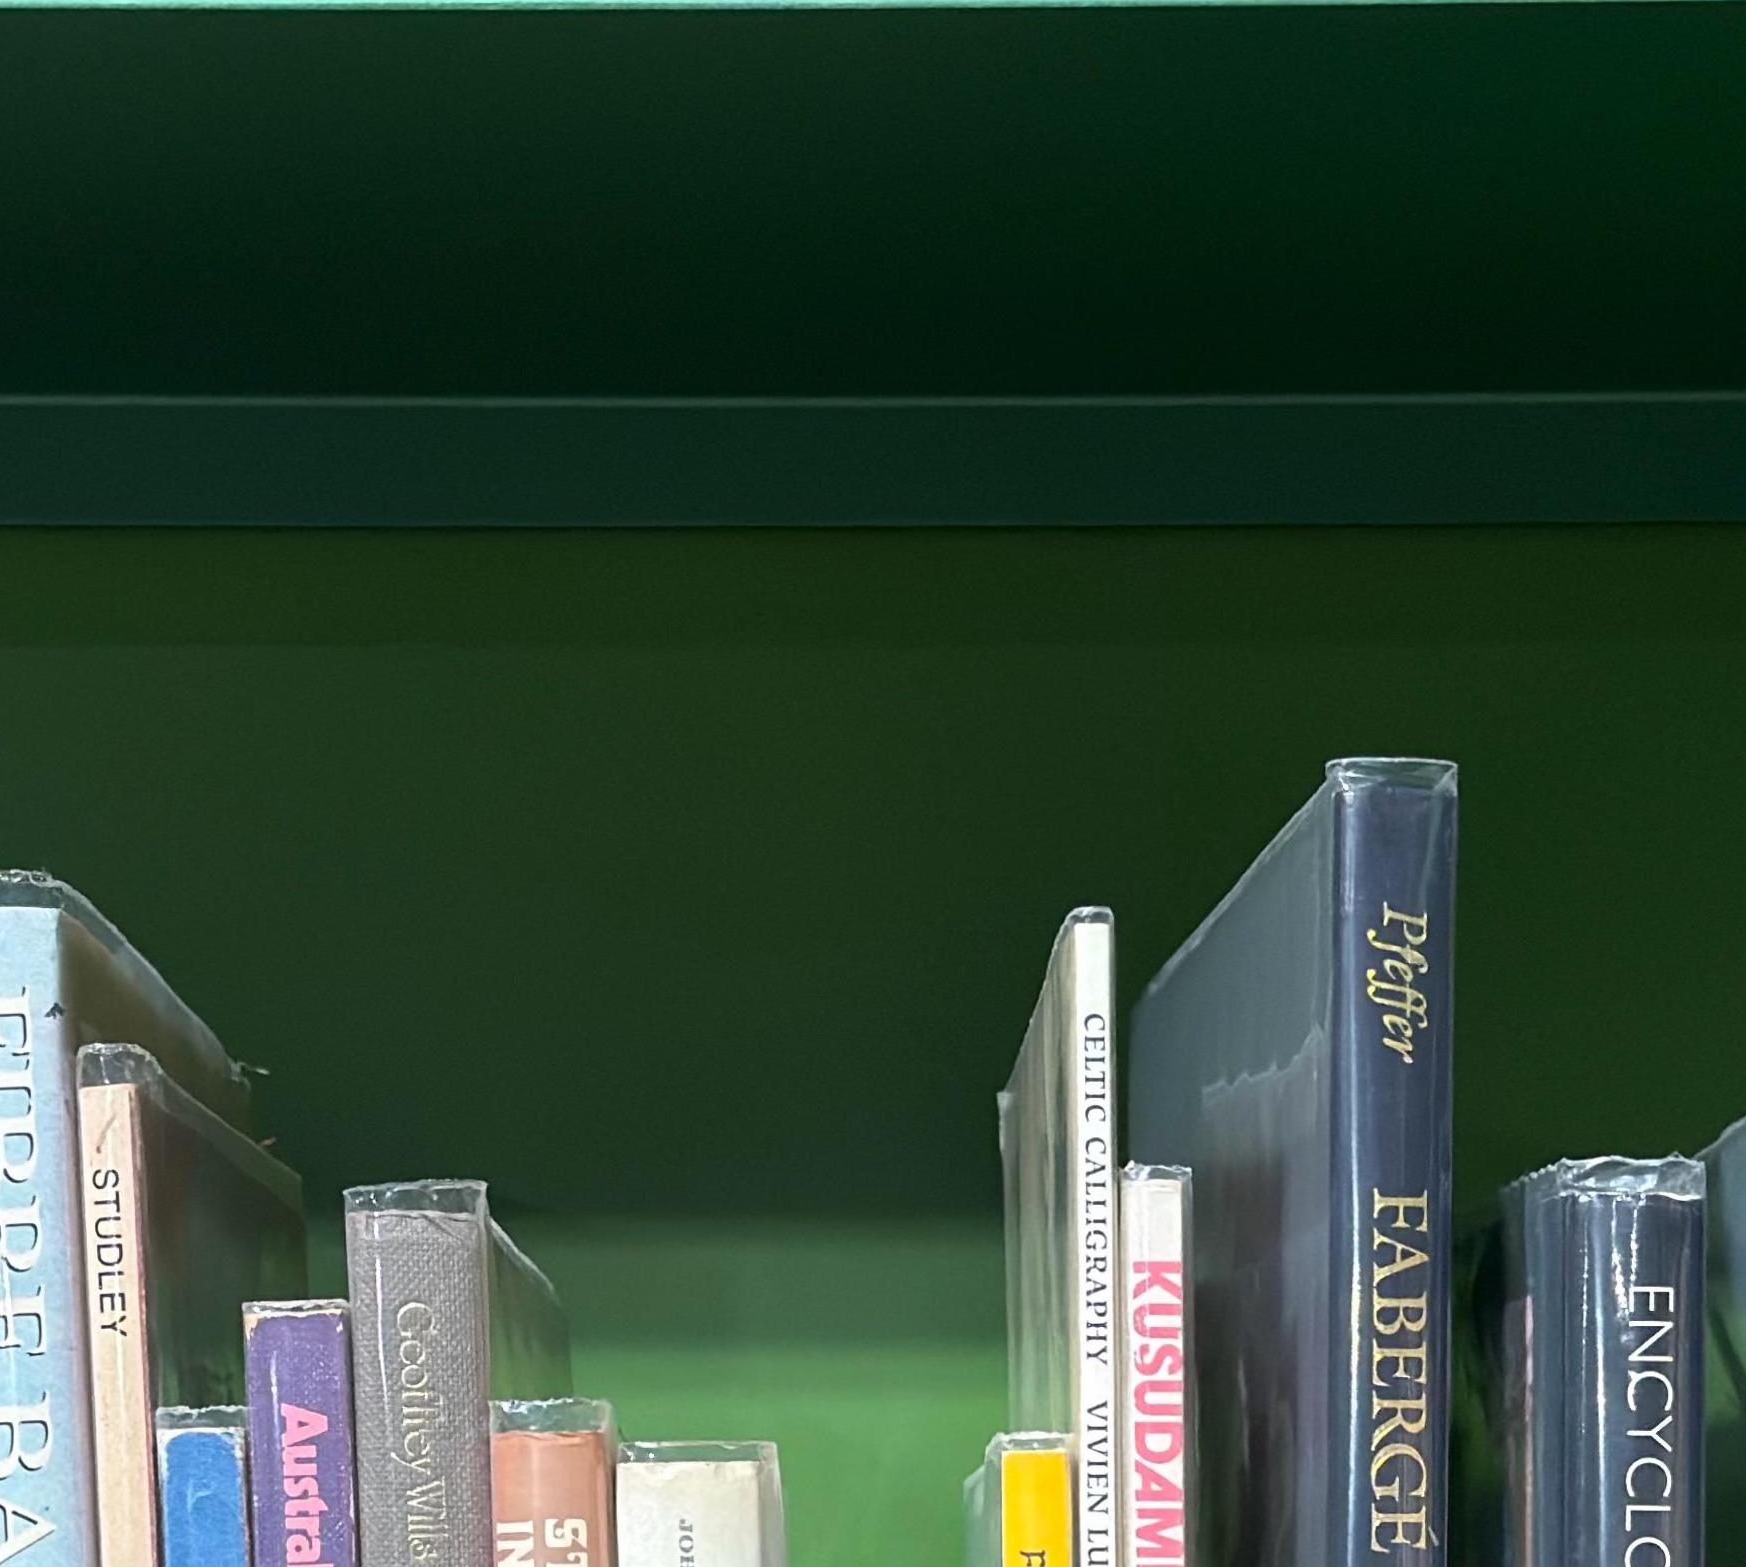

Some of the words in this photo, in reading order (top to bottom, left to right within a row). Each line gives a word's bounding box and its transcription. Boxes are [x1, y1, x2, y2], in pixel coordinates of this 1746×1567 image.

[1366, 902, 1430, 1065] Pfeffer
[1084, 1012, 1107, 1124] CELTIC
[92, 1168, 128, 1338] STUDLEY
[1084, 1136, 1109, 1367] CALLIGRAPHY
[1086, 1400, 1110, 1516] VIVIEN
